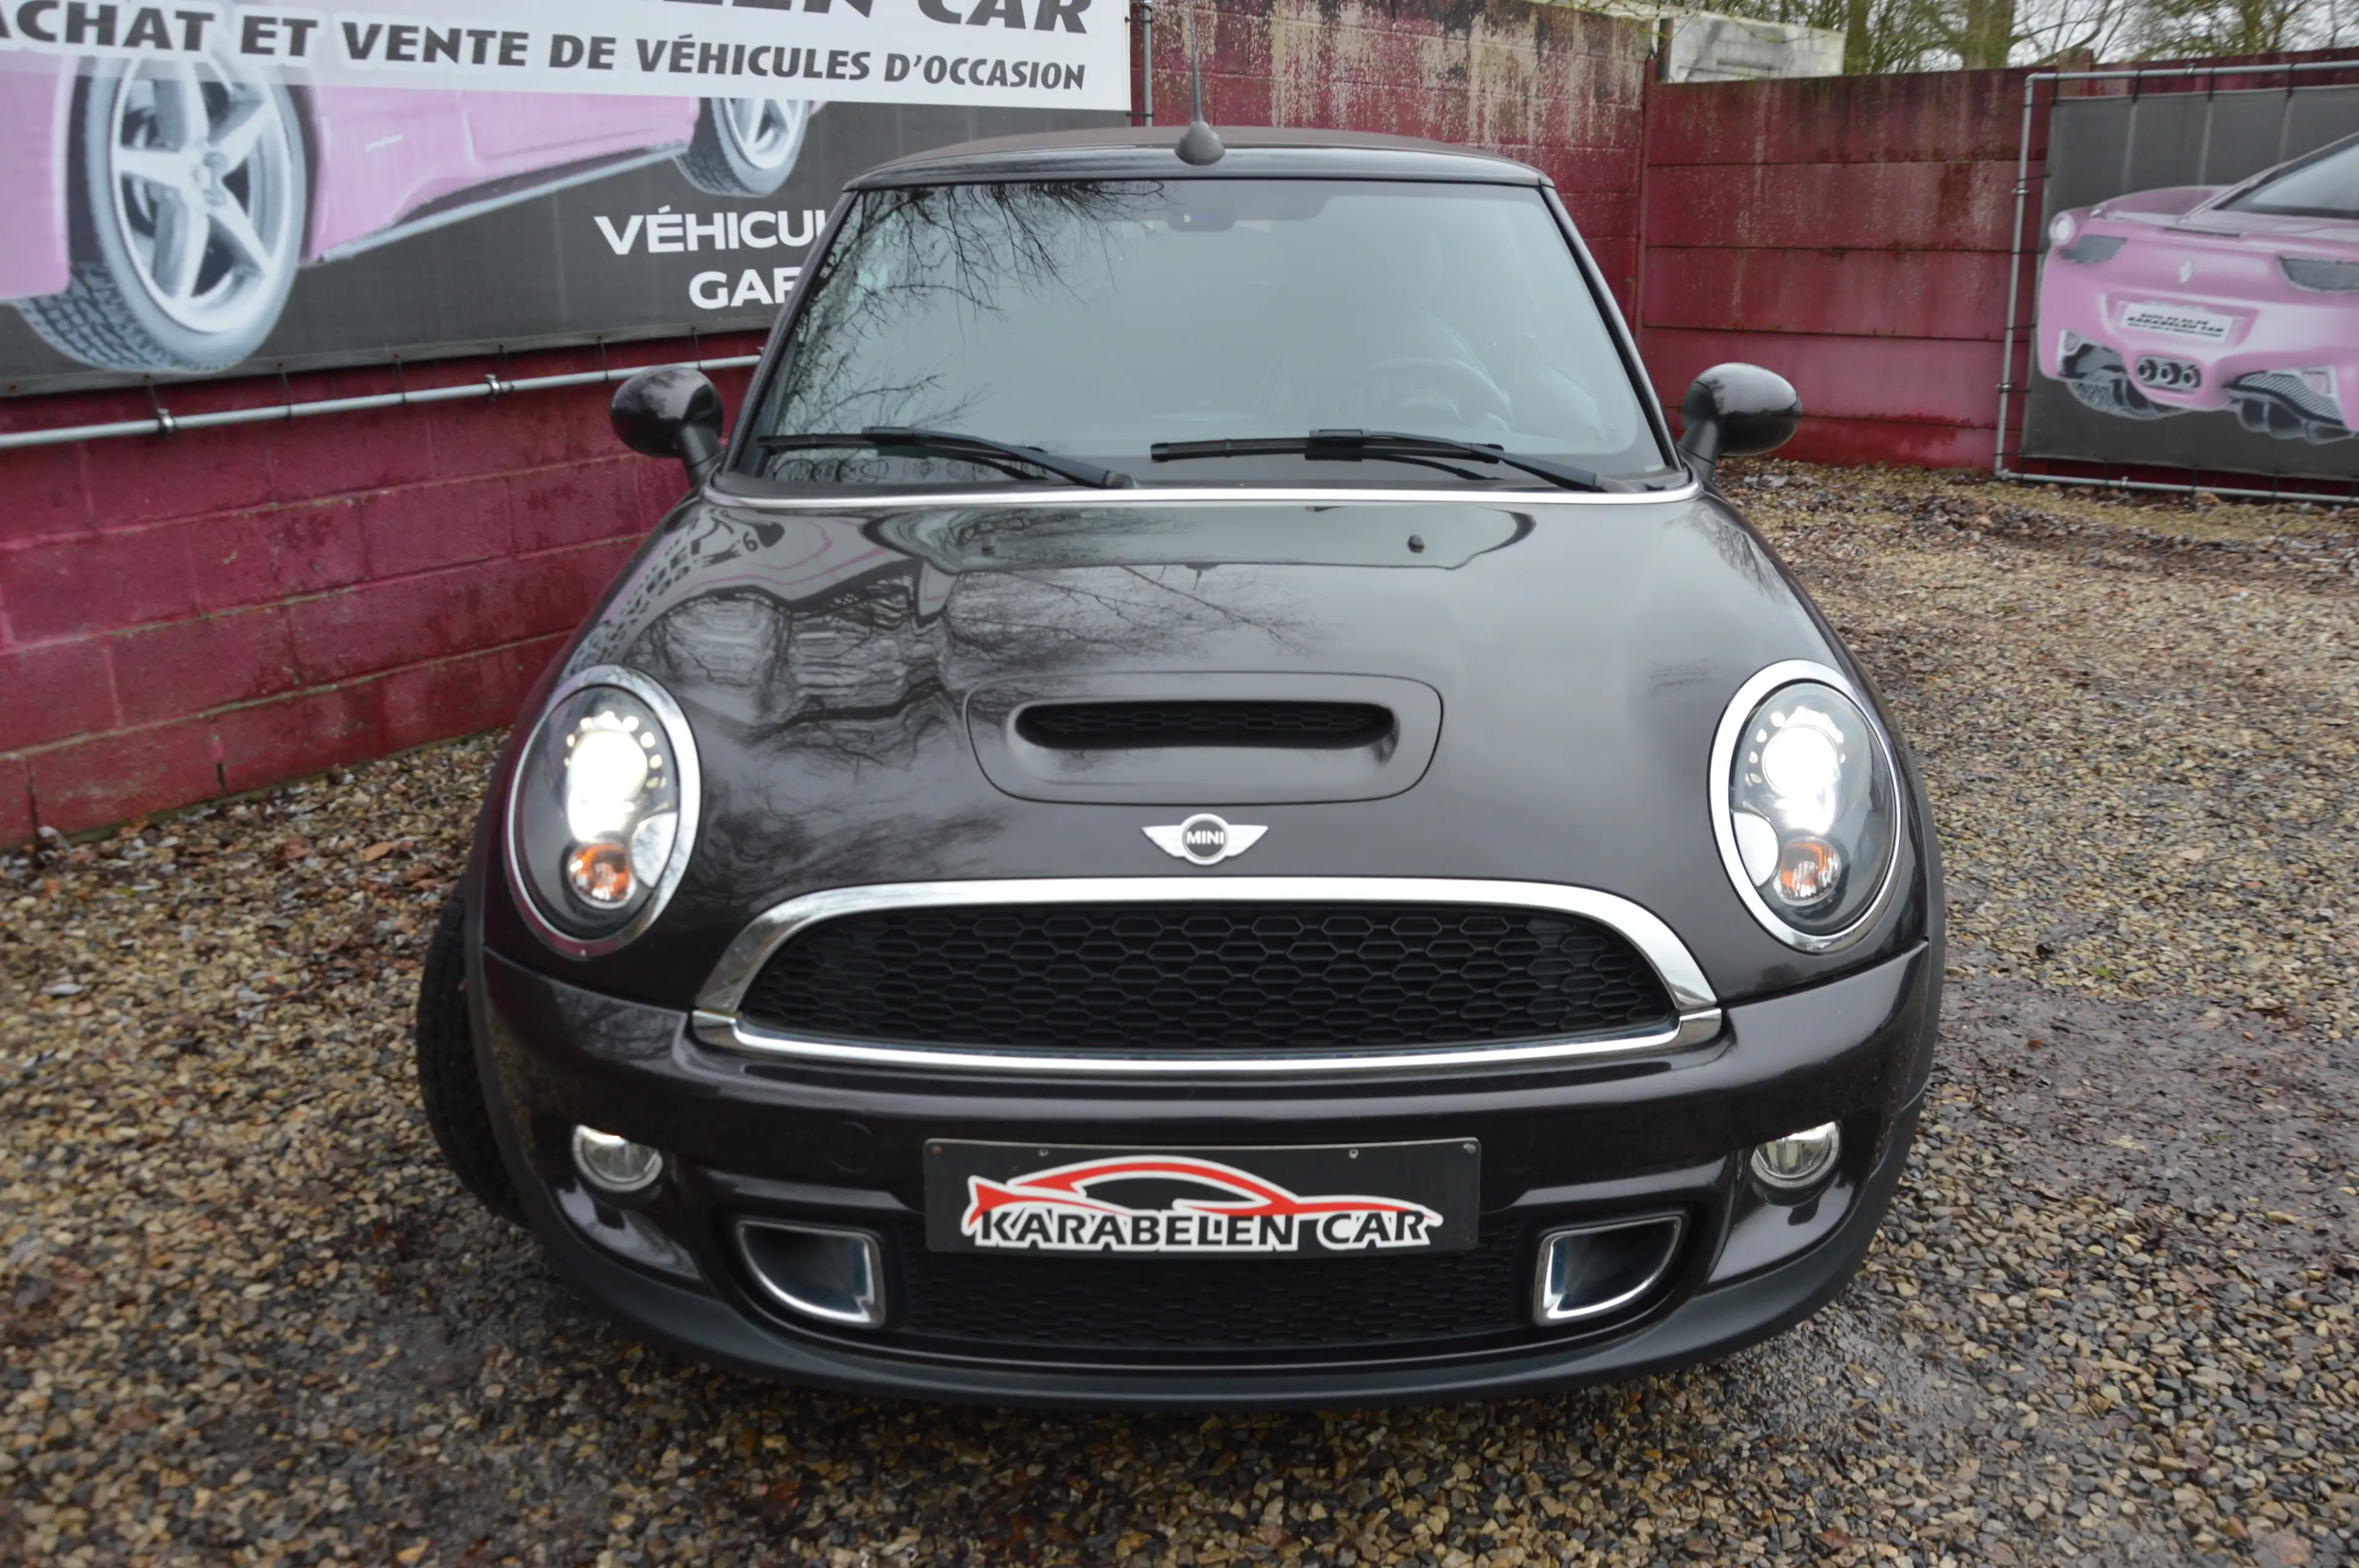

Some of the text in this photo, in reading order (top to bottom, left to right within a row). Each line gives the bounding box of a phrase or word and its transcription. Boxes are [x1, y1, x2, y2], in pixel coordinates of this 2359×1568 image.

[0, 0, 1086, 90] CHAT ET VENTE DE VÉHICULES D'OCCASION
[1186, 830, 1225, 845] MINI
[982, 1210, 1424, 1246] KARABELEN CAR
